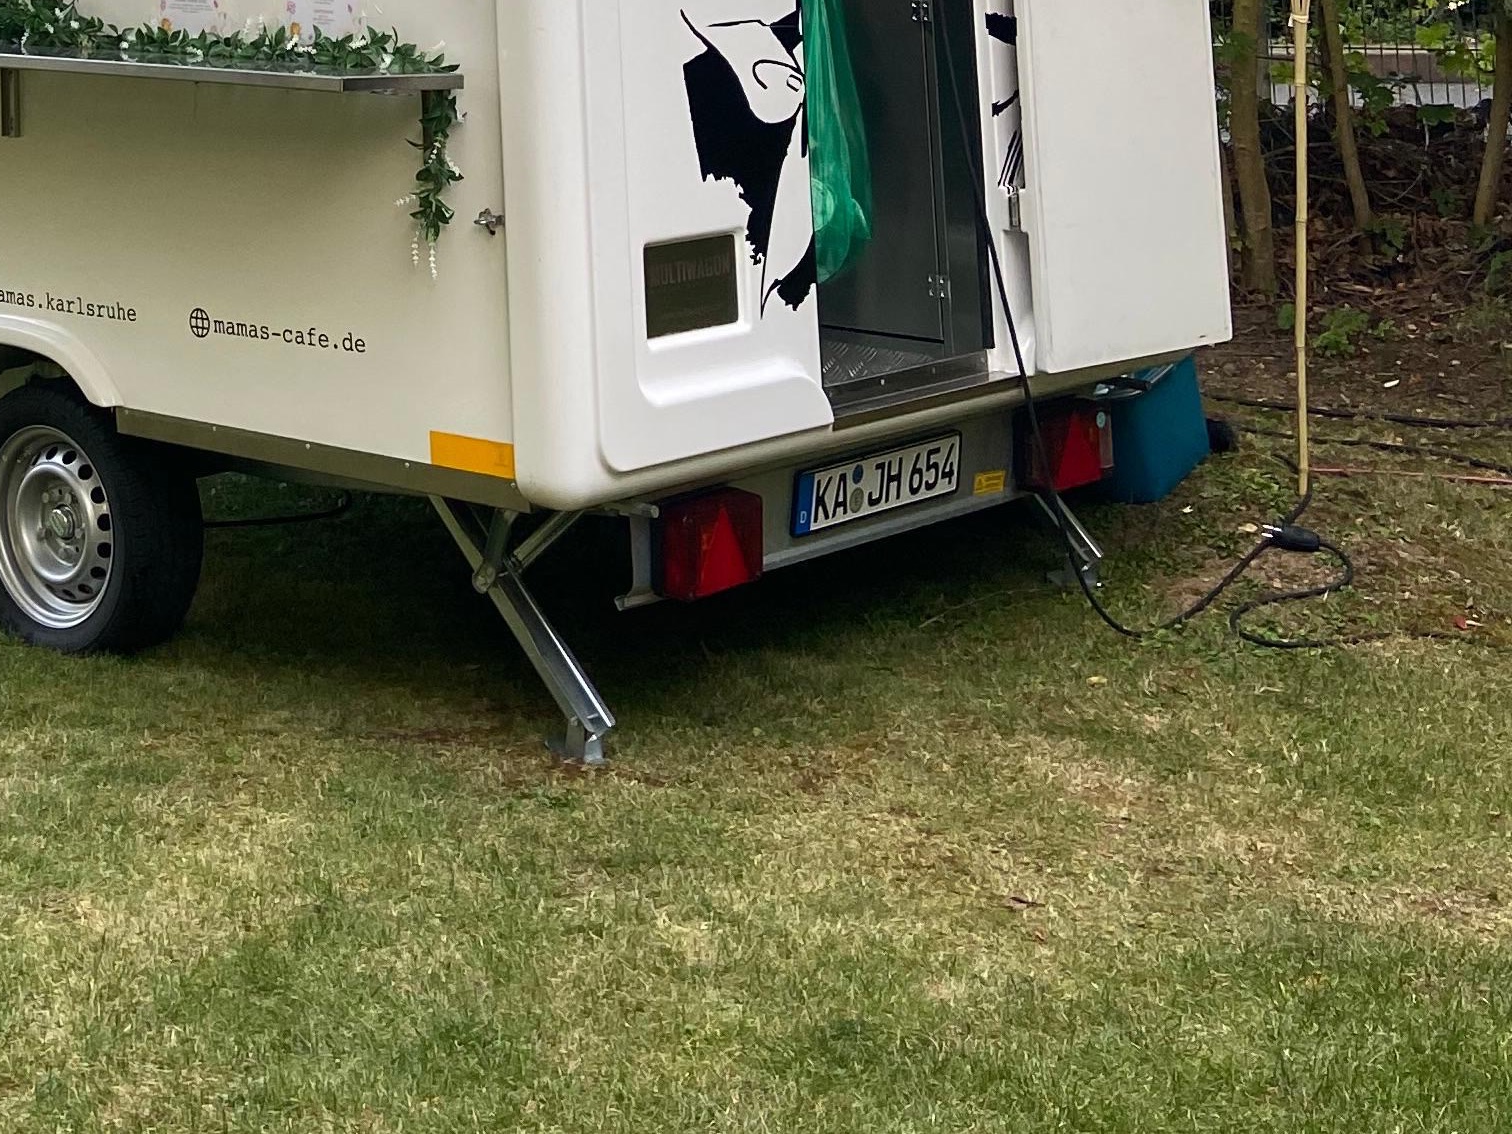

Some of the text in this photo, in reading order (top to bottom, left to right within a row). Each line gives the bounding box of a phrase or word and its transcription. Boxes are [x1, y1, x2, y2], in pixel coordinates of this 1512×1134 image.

[213, 319, 366, 353] mamas-cafe.de
[800, 442, 955, 524] D KA JH 654
